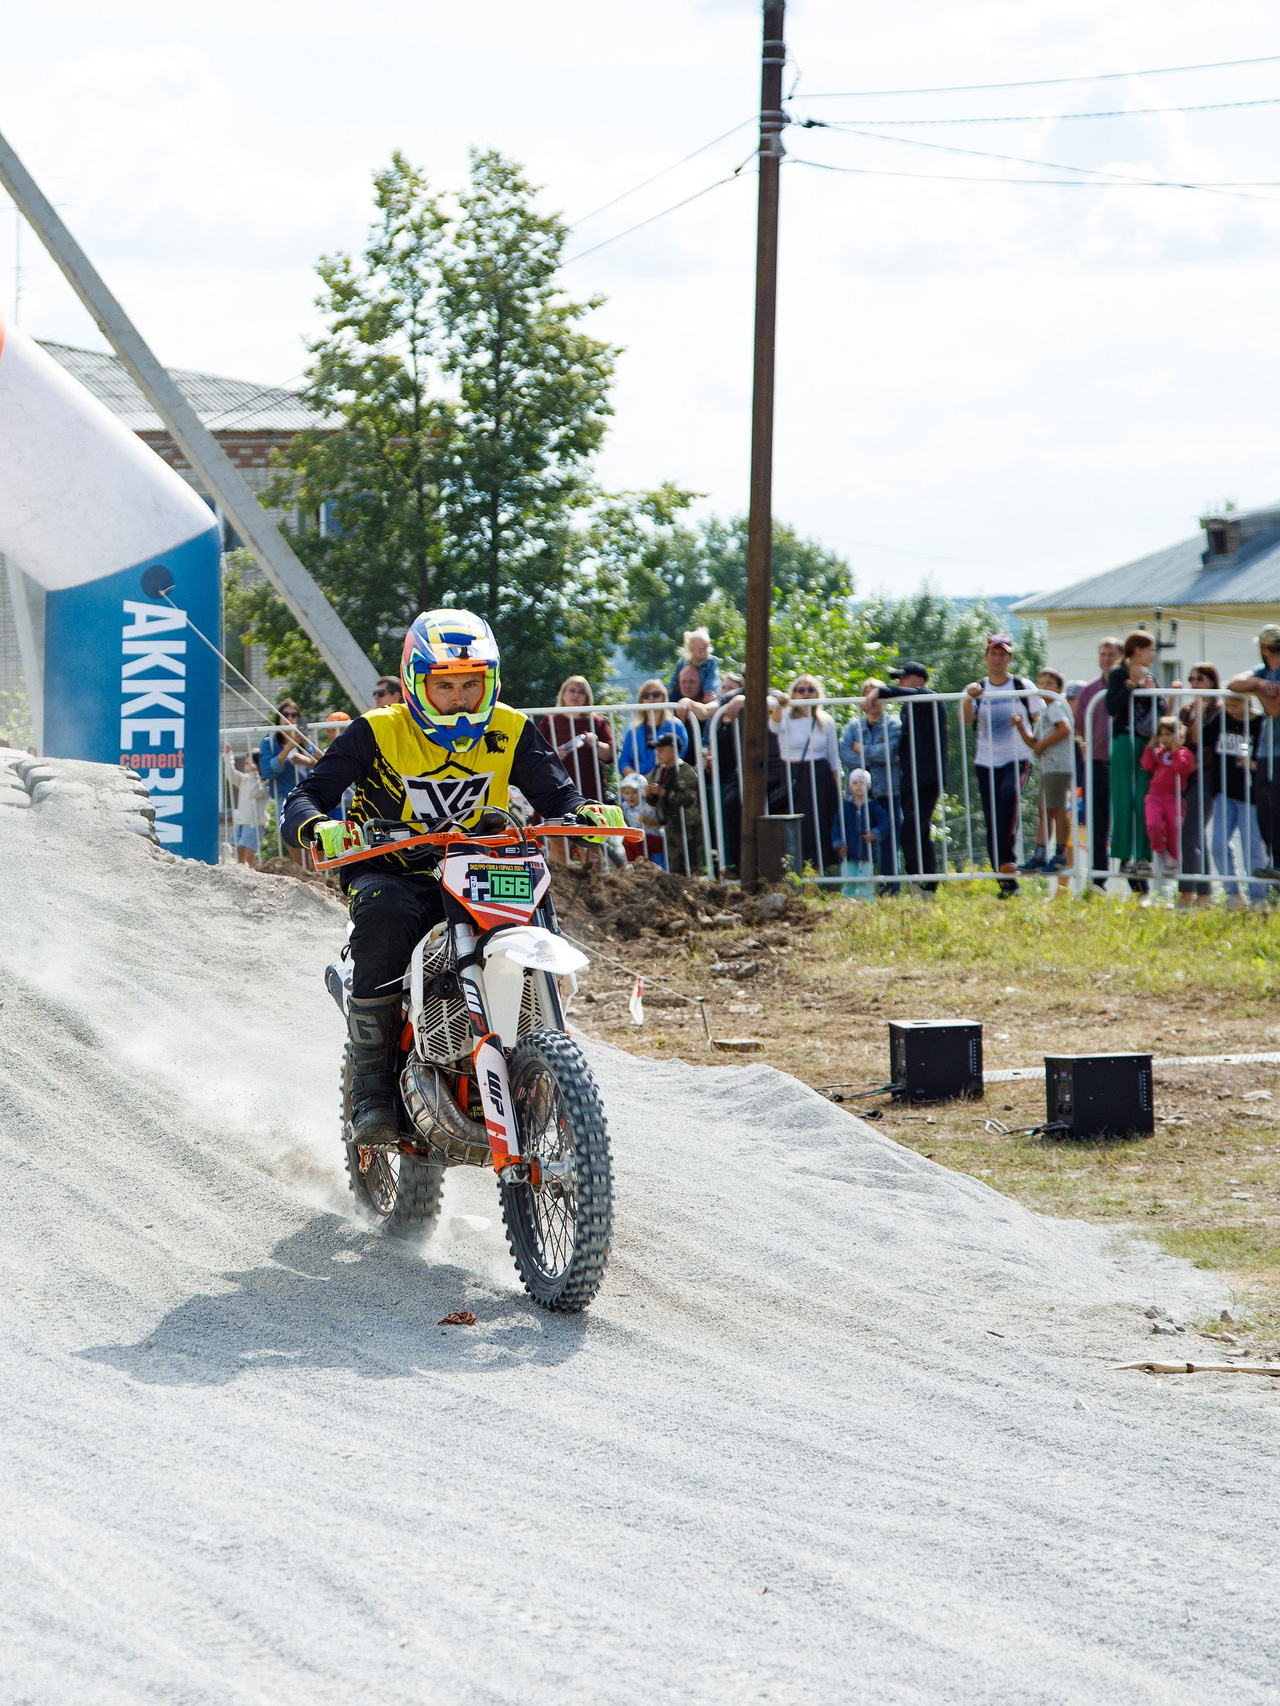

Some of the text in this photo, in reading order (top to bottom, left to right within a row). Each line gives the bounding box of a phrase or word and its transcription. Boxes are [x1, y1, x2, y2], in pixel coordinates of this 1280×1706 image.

[120, 599, 187, 858] AKKERM
[120, 749, 185, 769] cement
[491, 875, 530, 897] 166
